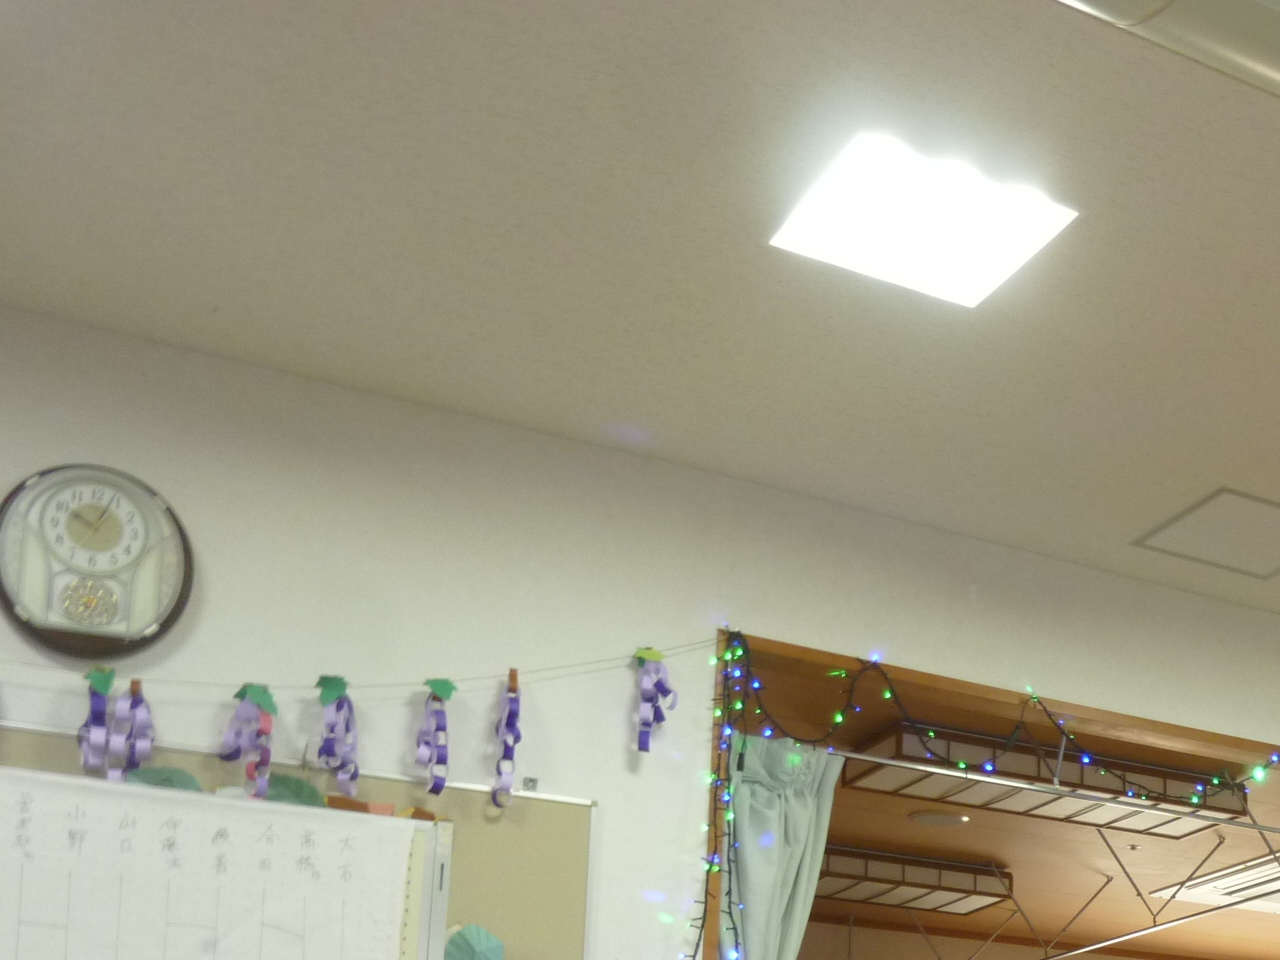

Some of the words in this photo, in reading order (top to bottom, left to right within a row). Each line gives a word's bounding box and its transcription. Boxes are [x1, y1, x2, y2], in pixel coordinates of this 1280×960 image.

[71, 489, 83, 503] 11
[91, 488, 105, 501] 12
[56, 499, 70, 514] 10
[114, 497, 121, 509] 1
[51, 516, 59, 528] 9
[126, 511, 135, 523] 2
[56, 534, 64, 545] 8
[130, 528, 139, 542] 3
[69, 546, 77, 560] 7
[124, 544, 132, 556] 4
[88, 554, 97, 567] 6
[110, 553, 119, 566] 5
